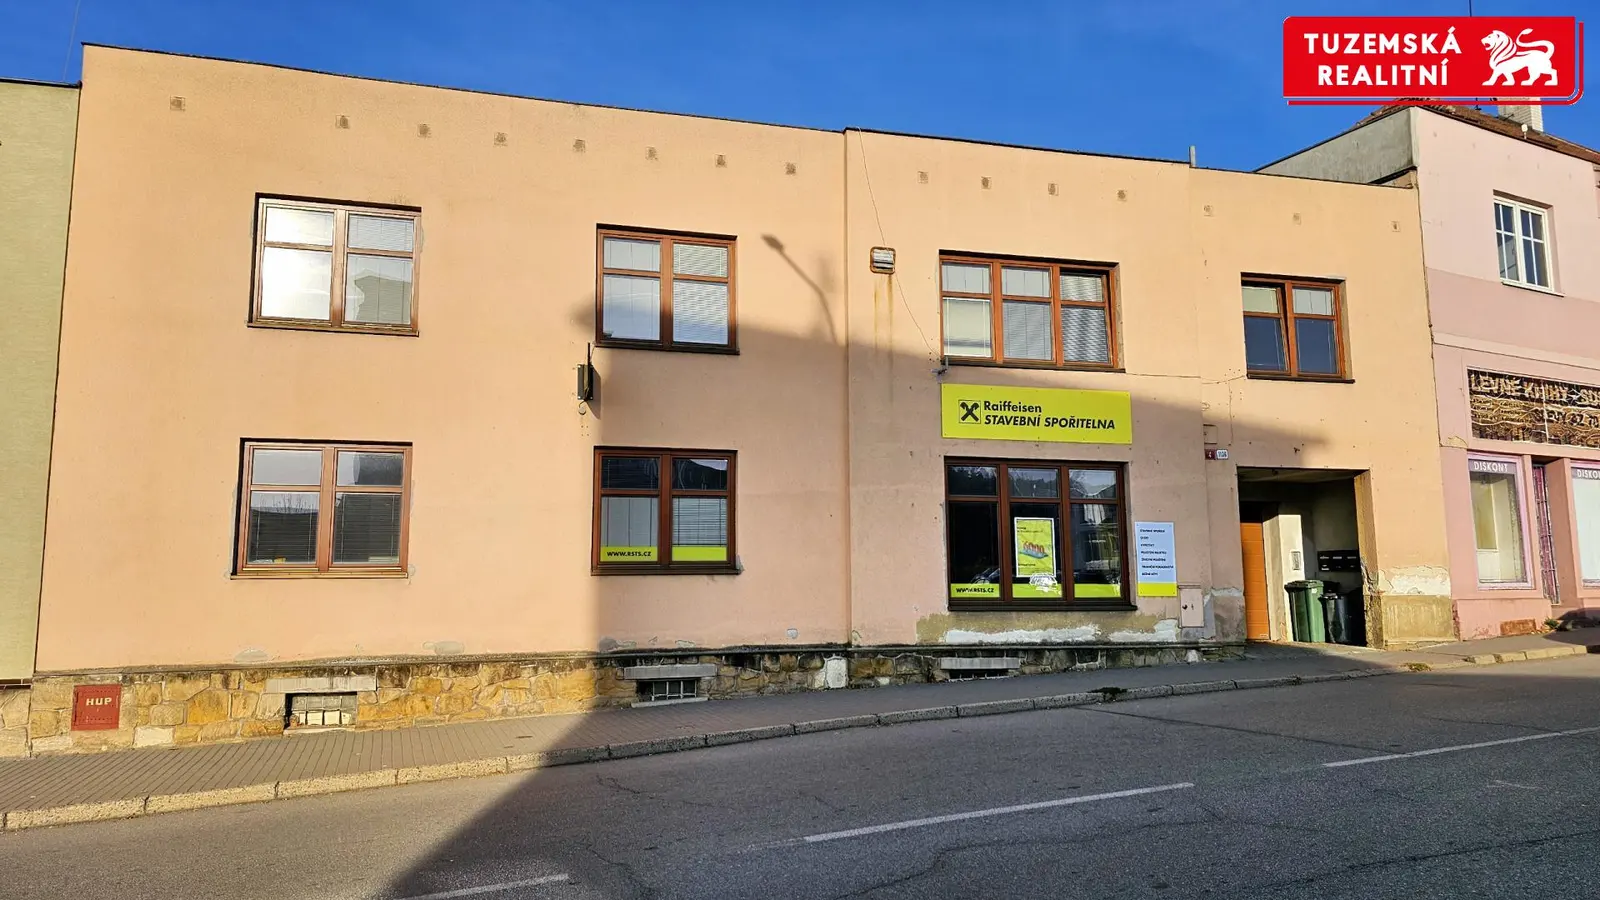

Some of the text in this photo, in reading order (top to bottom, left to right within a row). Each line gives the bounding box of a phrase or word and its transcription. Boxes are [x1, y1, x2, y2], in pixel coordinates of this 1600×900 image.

[983, 400, 1042, 413] Raiffeisen
[984, 414, 1116, 430] STAVEBNÍ SPOŘITELNA
[1473, 460, 1508, 473] DISKONT
[86, 697, 112, 706] HUP
